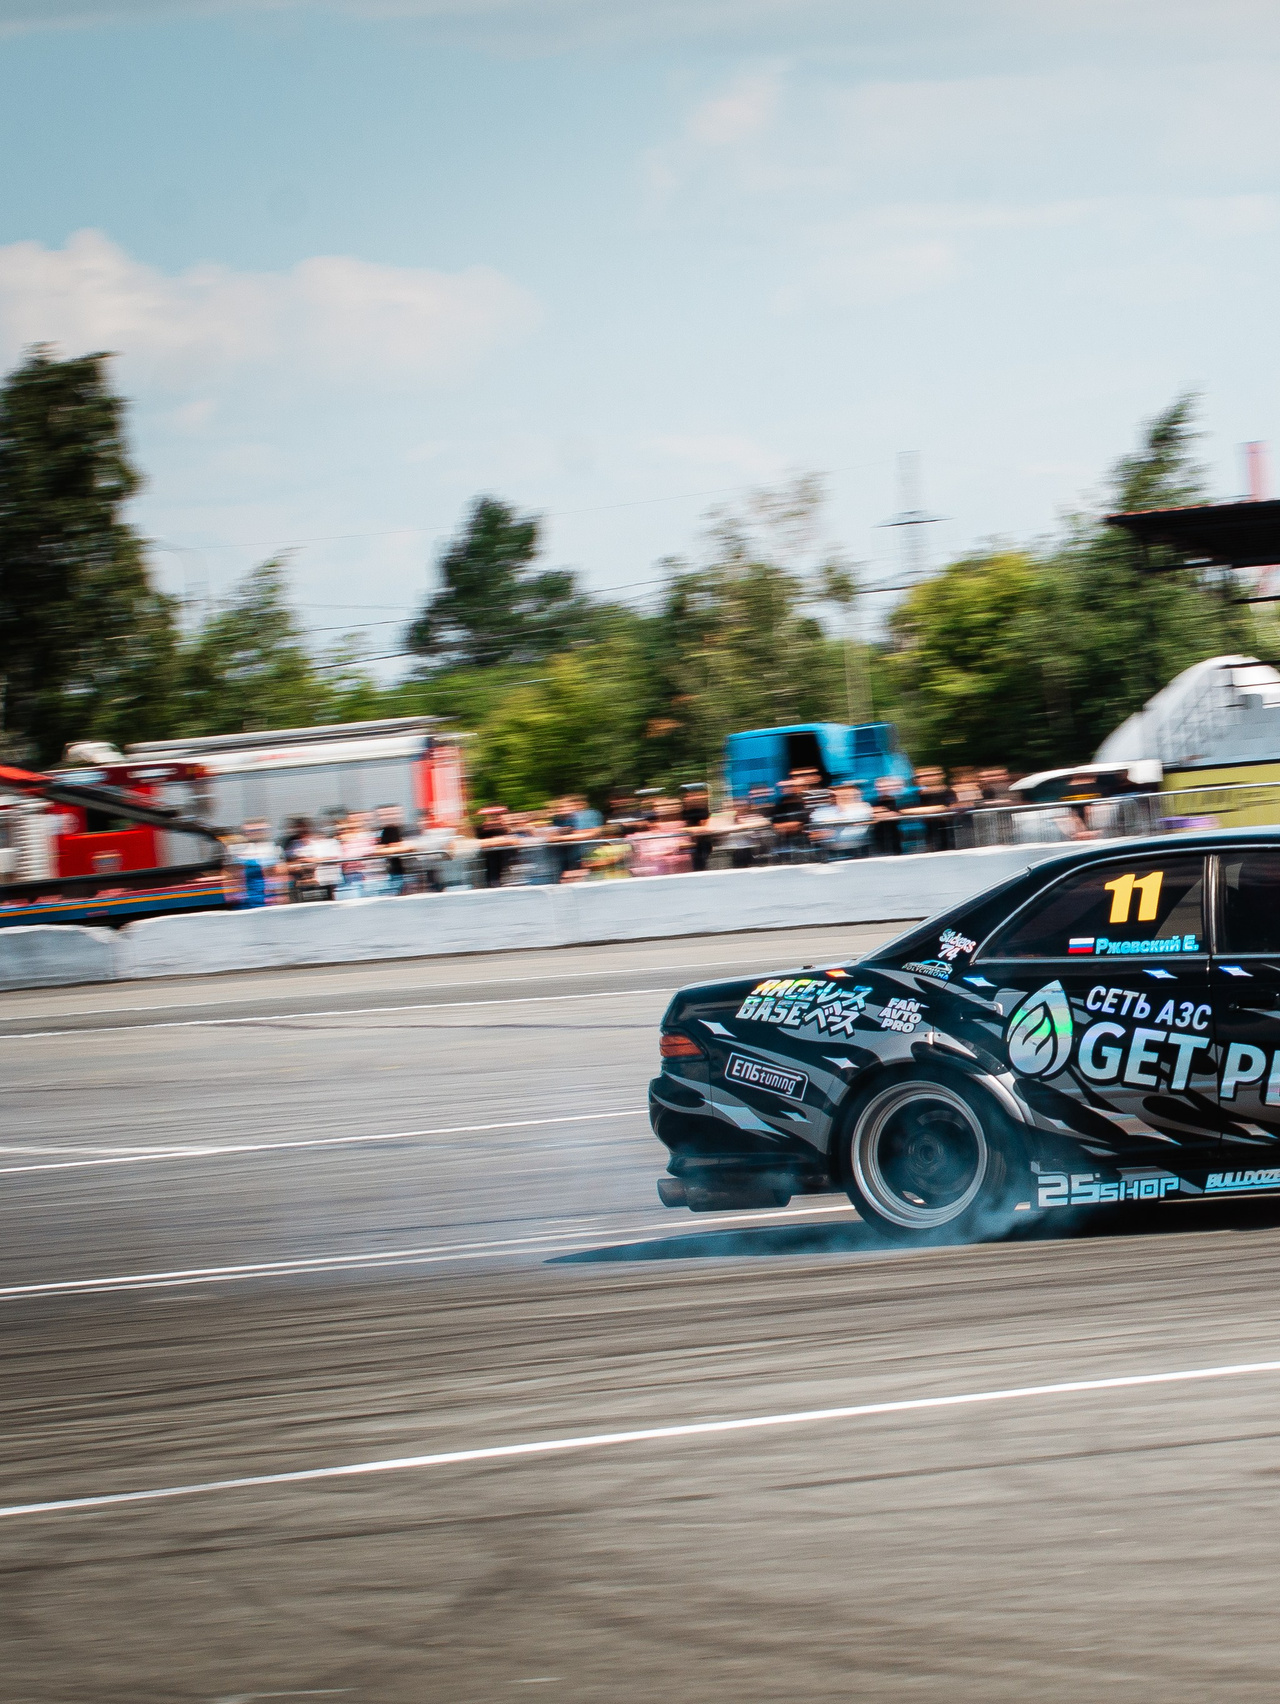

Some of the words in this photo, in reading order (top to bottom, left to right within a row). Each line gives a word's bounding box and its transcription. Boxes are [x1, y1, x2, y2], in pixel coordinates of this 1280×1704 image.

[1104, 871, 1164, 923] 11
[937, 943, 961, 961] 74
[1095, 935, 1182, 955] Ржевский
[751, 979, 826, 1001] RACE
[735, 995, 811, 1027] BASE
[878, 1007, 923, 1024] AVTO
[1086, 985, 1152, 1018] СЕТЬ
[1155, 1000, 1212, 1030] АЗС
[880, 1017, 916, 1034] PRO
[1078, 1022, 1210, 1091] GET
